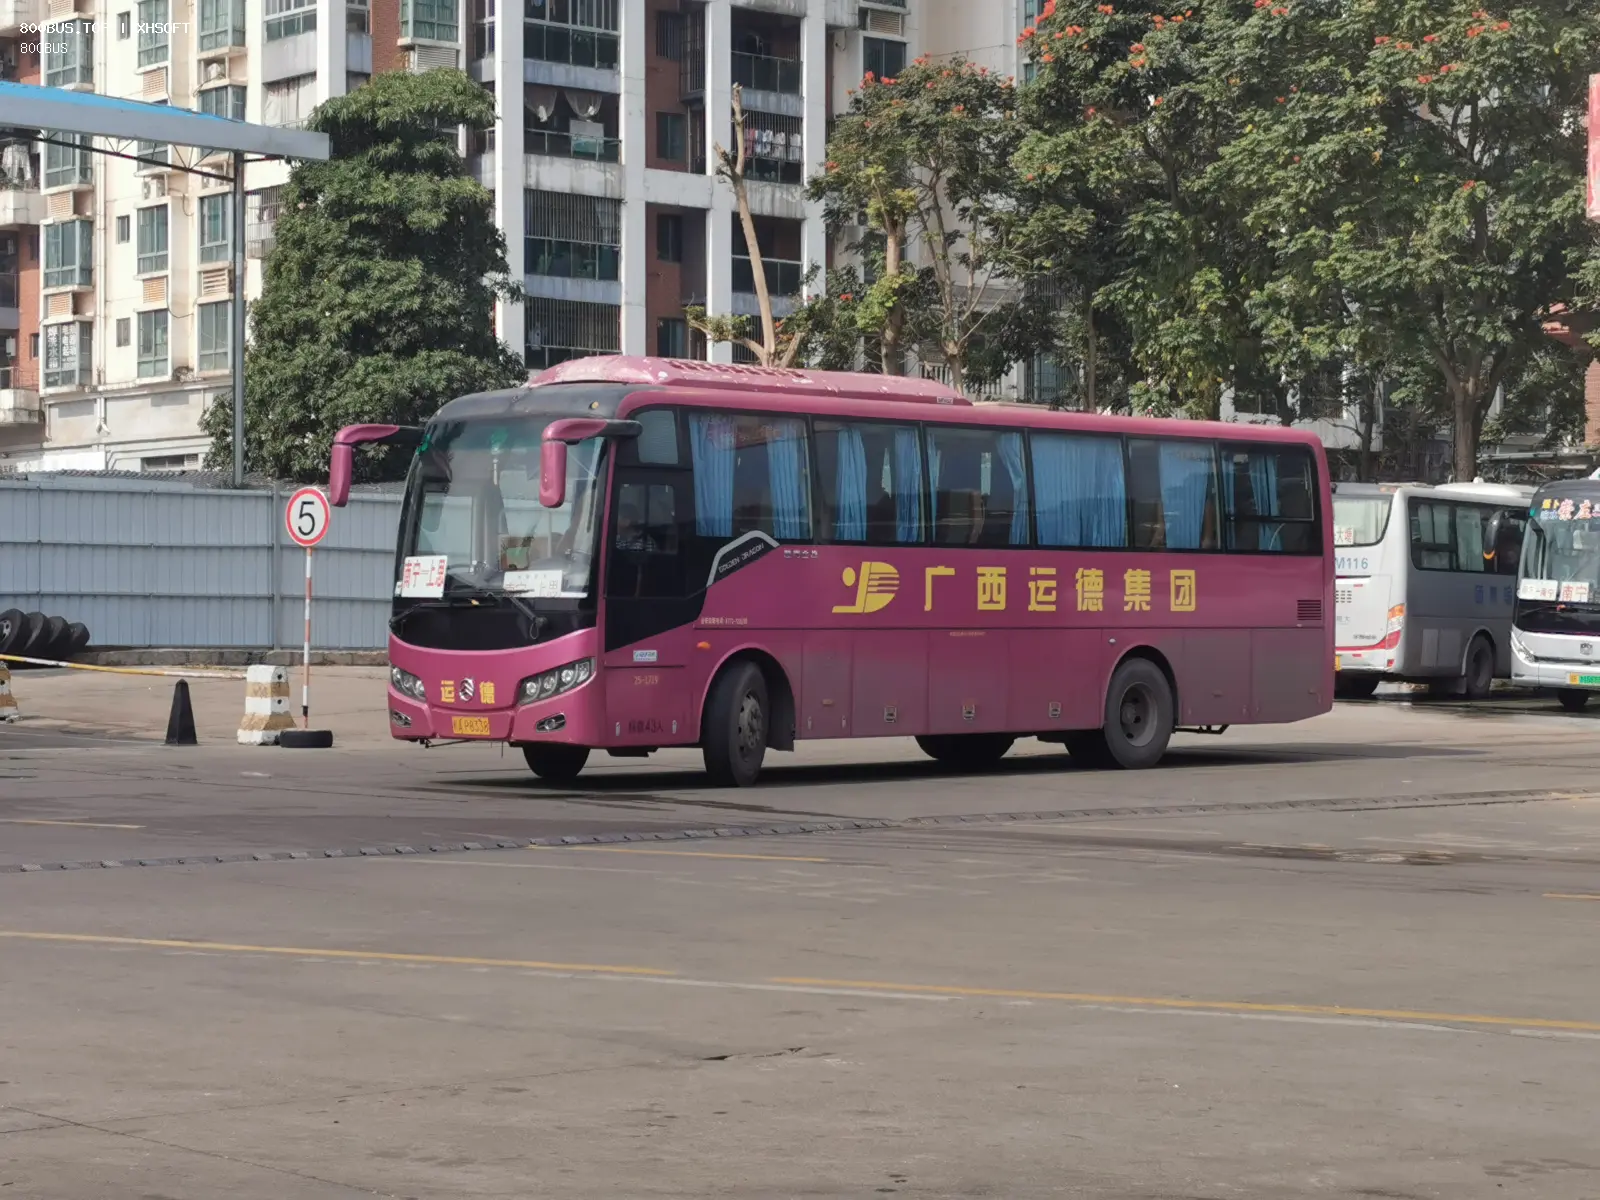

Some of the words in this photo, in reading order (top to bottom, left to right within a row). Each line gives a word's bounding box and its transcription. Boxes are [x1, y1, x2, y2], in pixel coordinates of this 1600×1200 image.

[298, 500, 315, 536] 5
[718, 556, 741, 574] GOLDEN
[741, 543, 764, 561] DRAGON
[924, 565, 1197, 612] 广西运德集团
[1562, 584, 1588, 602] 南宁
